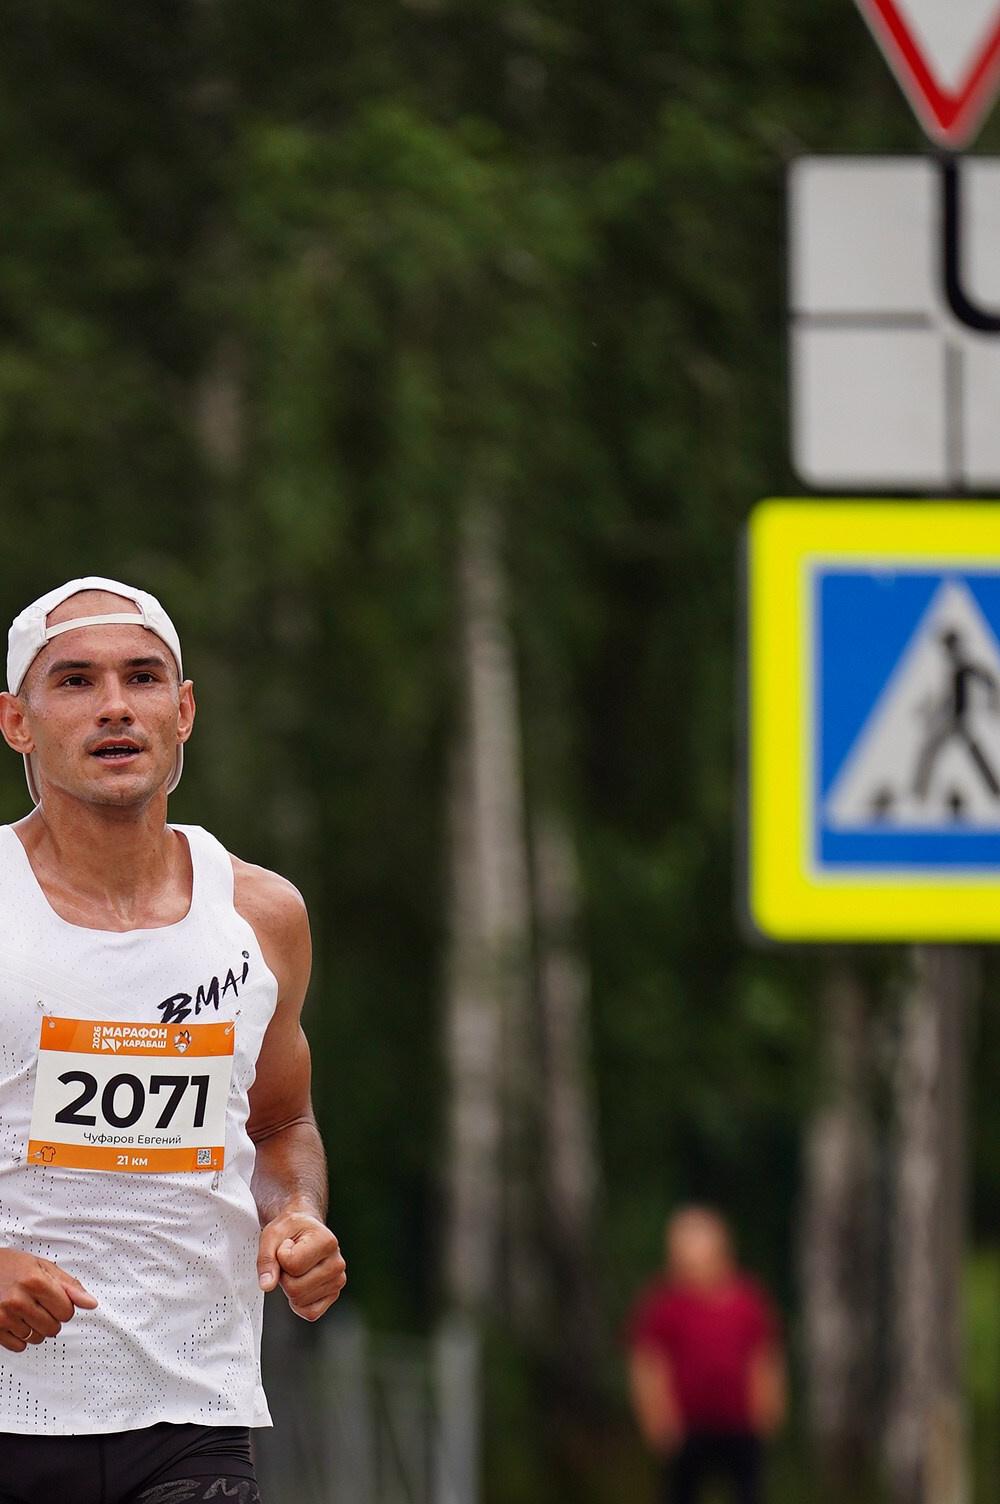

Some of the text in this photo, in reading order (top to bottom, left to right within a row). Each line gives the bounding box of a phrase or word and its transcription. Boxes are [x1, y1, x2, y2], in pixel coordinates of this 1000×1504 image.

[92, 1026, 101, 1049] 2026
[102, 1026, 168, 1039] МАРАФОН
[122, 1039, 167, 1049] КАРАБАШ
[54, 1070, 210, 1129] 2071
[84, 1132, 182, 1145] Чуфаров Евгений
[117, 1155, 148, 1166] 21 км
